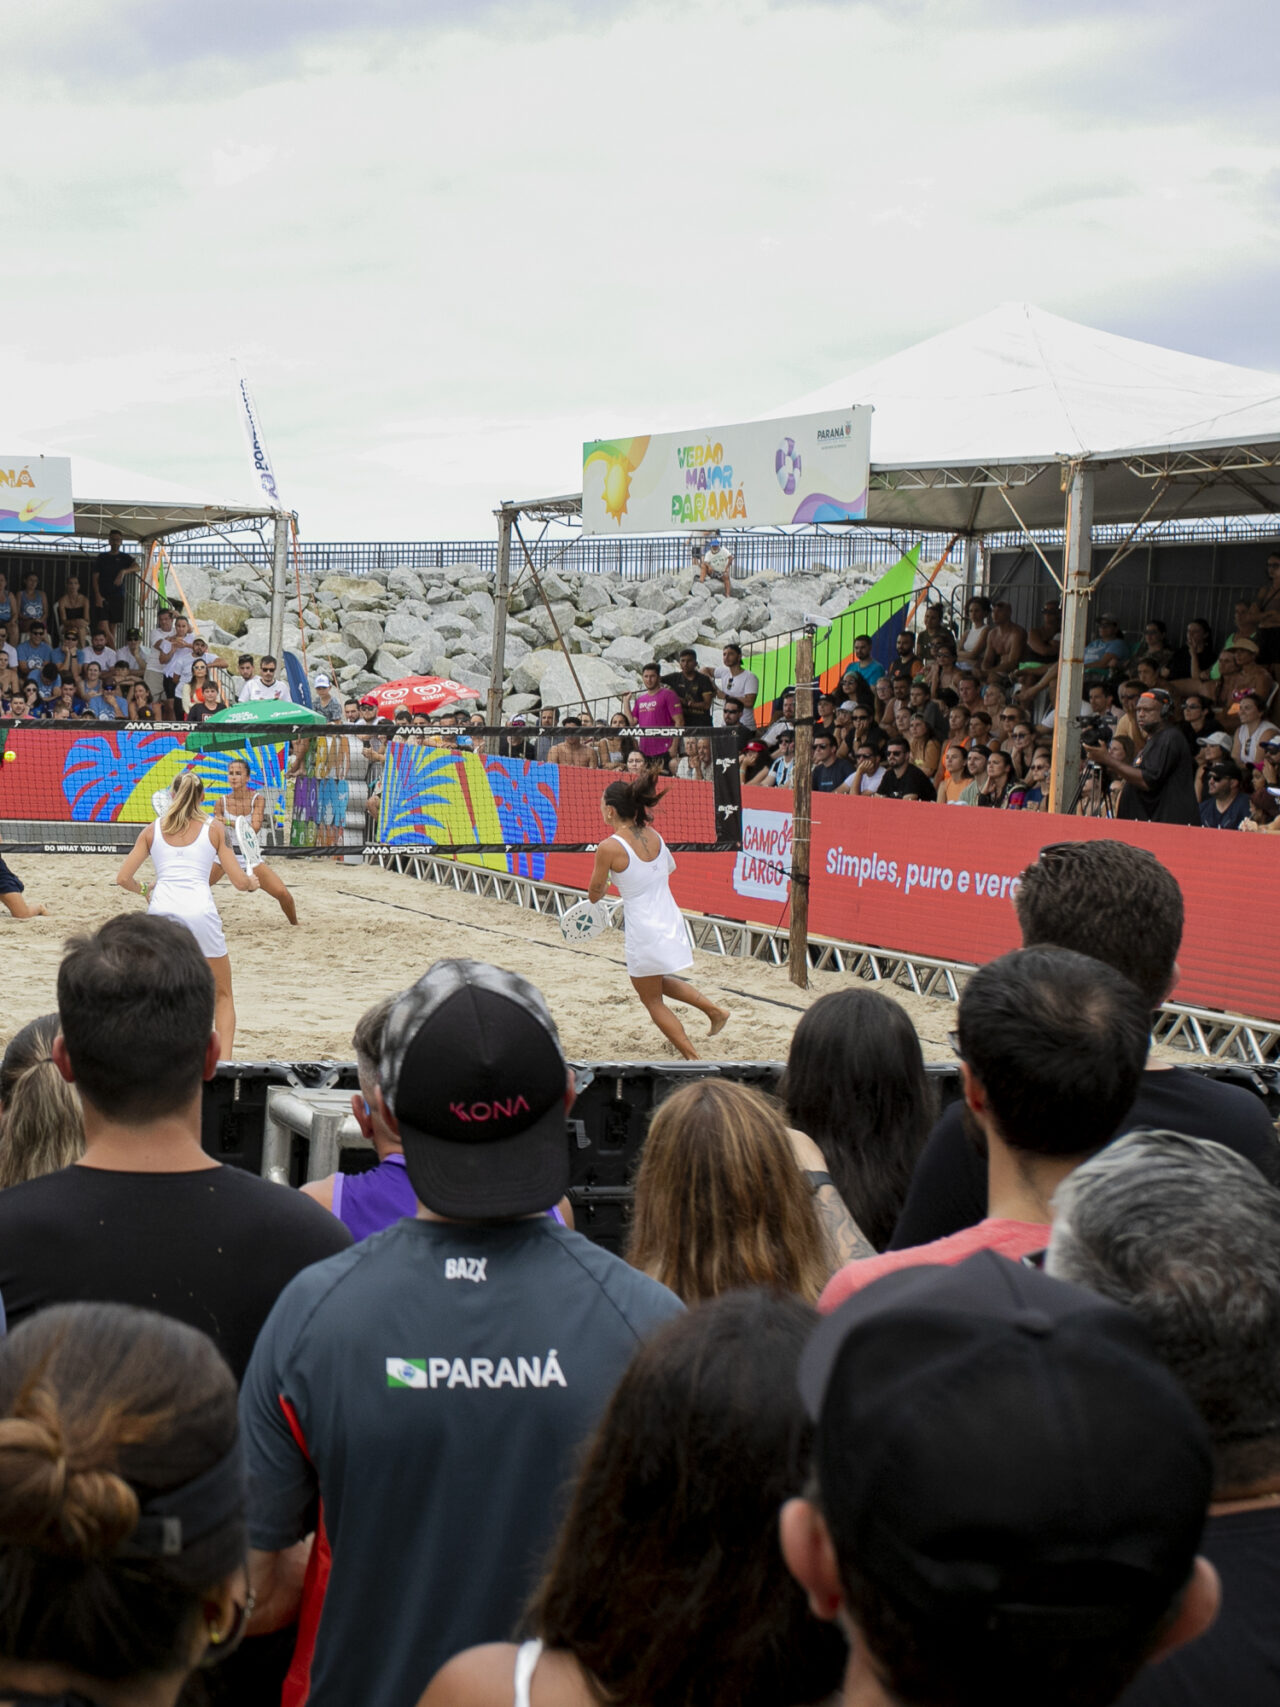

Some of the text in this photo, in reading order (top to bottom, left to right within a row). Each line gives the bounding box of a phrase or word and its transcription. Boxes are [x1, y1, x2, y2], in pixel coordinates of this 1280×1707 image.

[817, 426, 845, 440] PARANÁ
[677, 435, 723, 469] VERÃO
[685, 465, 733, 490] MAIOR
[672, 482, 747, 524] PARANÁ
[124, 722, 198, 731] AMA SPORT
[423, 727, 466, 735] SPORT
[618, 728, 685, 736] AMA SPORT
[44, 844, 54, 852] DO
[362, 846, 432, 854] AMA SPORT
[743, 826, 786, 856] CAMPO
[741, 856, 784, 886] LARGO
[826, 846, 901, 888] Simples,
[905, 863, 953, 894] puro
[957, 870, 970, 892] e
[449, 1095, 531, 1122] KONA
[428, 1348, 567, 1389] PARANÁ
